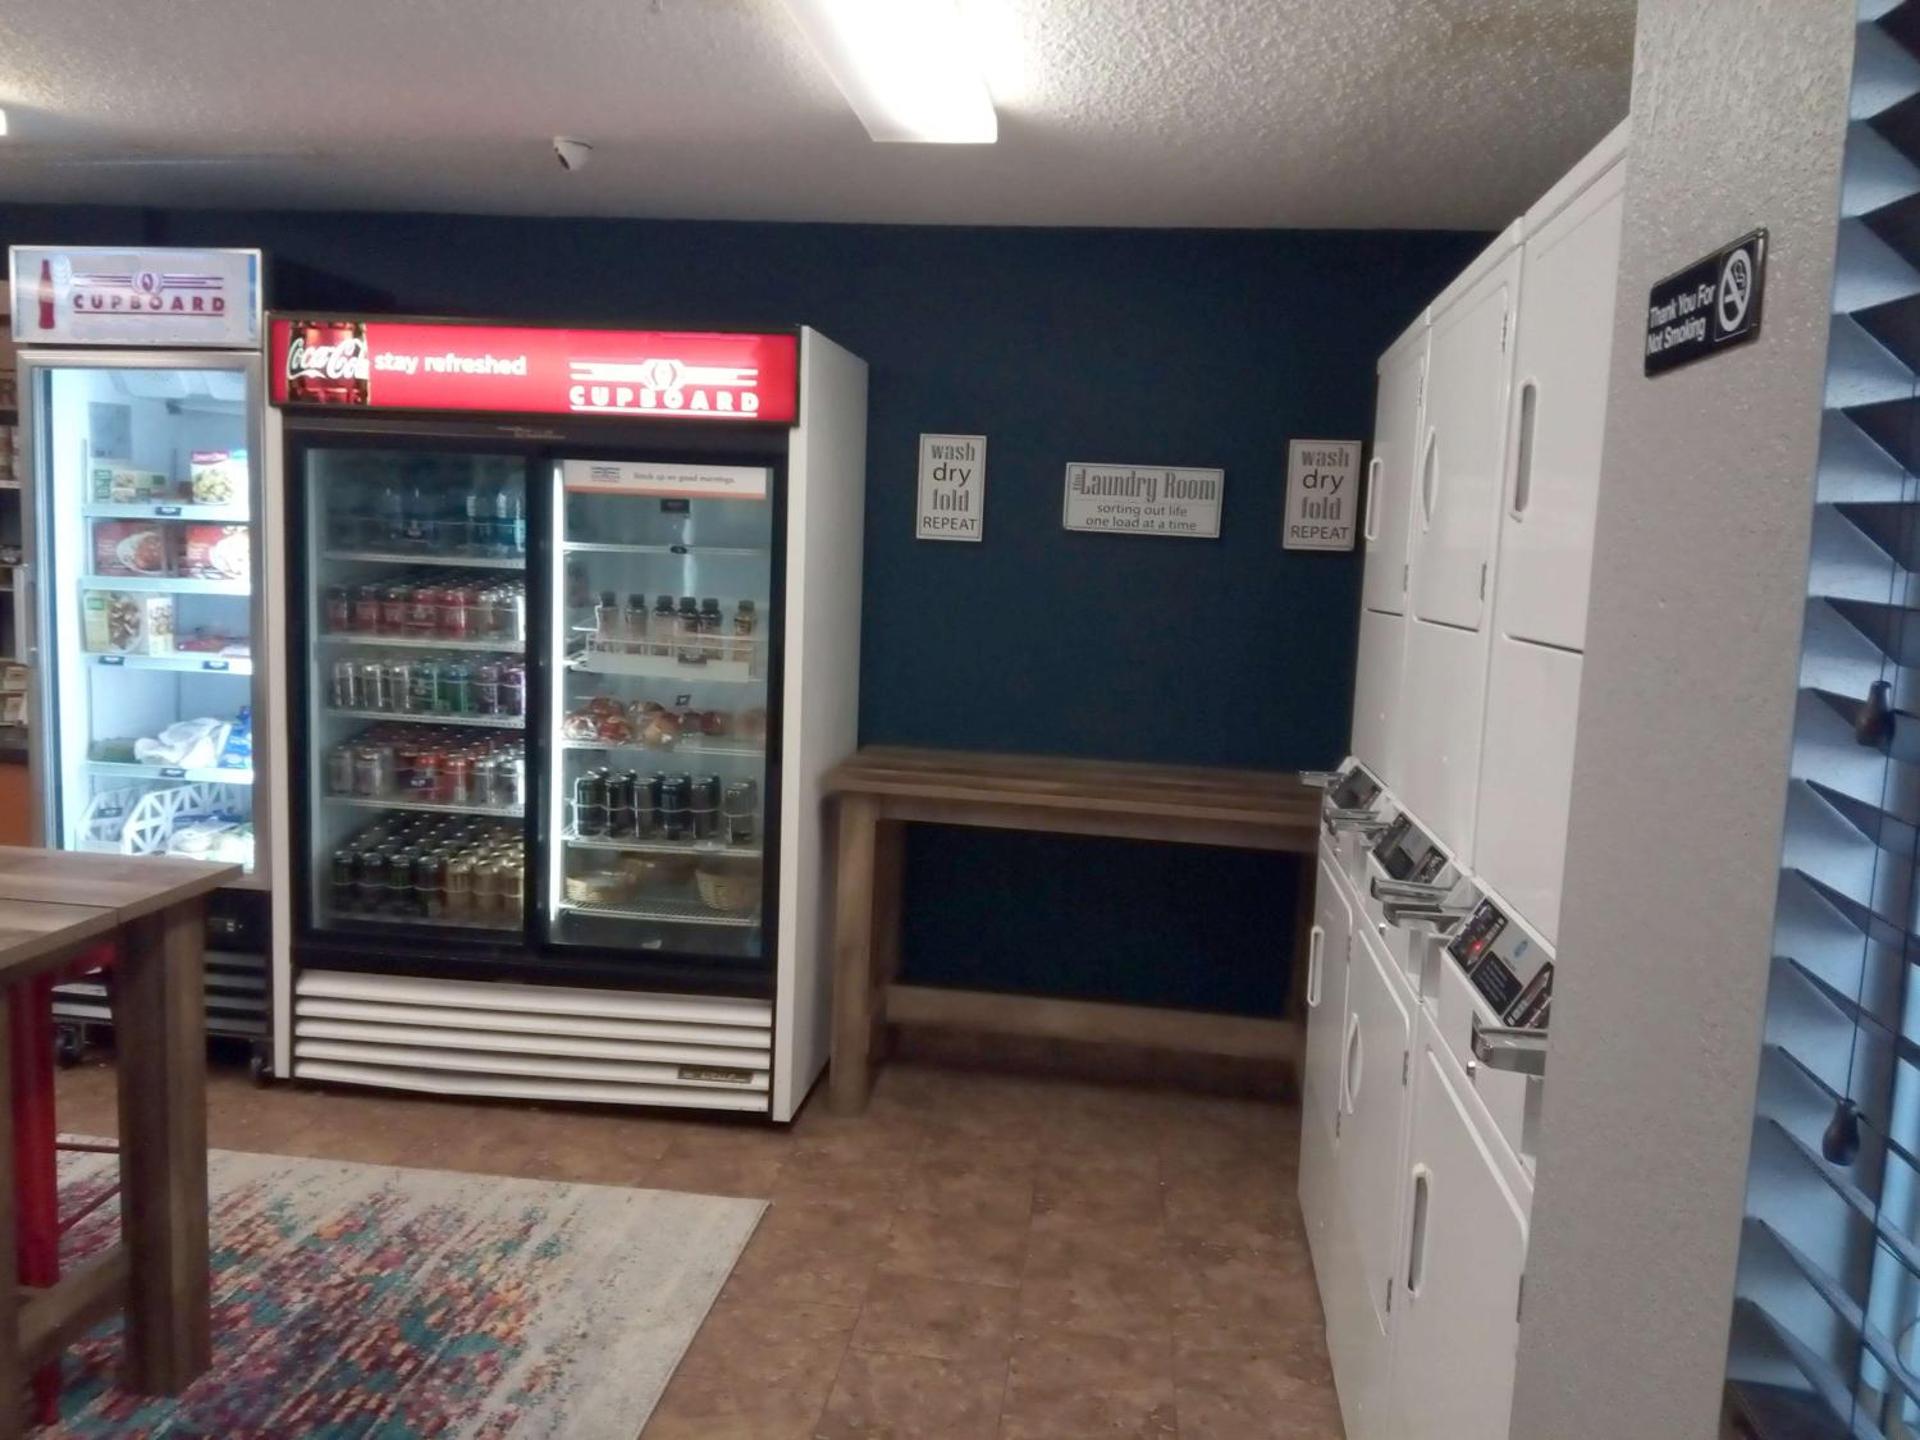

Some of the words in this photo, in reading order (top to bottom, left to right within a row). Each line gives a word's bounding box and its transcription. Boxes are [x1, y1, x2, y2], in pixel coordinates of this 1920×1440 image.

[73, 294, 225, 312] CUPBOARD
[1650, 298, 1677, 329] Thank
[1678, 293, 1697, 316] You
[1697, 284, 1717, 308] For
[1648, 331, 1663, 356] Not
[1664, 316, 1706, 349] Smoking
[375, 351, 419, 375] stay
[424, 352, 528, 377] refreshed
[569, 385, 759, 412] CUPBOARD
[931, 442, 975, 461] wash
[1302, 448, 1349, 467] wash
[933, 462, 972, 488] dry
[1080, 469, 1157, 502] Laundry
[1164, 472, 1216, 500] Room
[1302, 468, 1345, 495] dry
[932, 489, 969, 512] fold
[1097, 503, 1141, 517] sorting
[1144, 505, 1165, 516] out
[1169, 506, 1188, 517] life
[1301, 496, 1341, 520] fold
[923, 516, 978, 531] REPEAT
[1086, 517, 1110, 527] one
[1113, 516, 1140, 528] load
[1142, 519, 1155, 529] at
[1158, 521, 1165, 530] a
[1168, 520, 1197, 530] time
[1291, 525, 1349, 540] REPEAT
